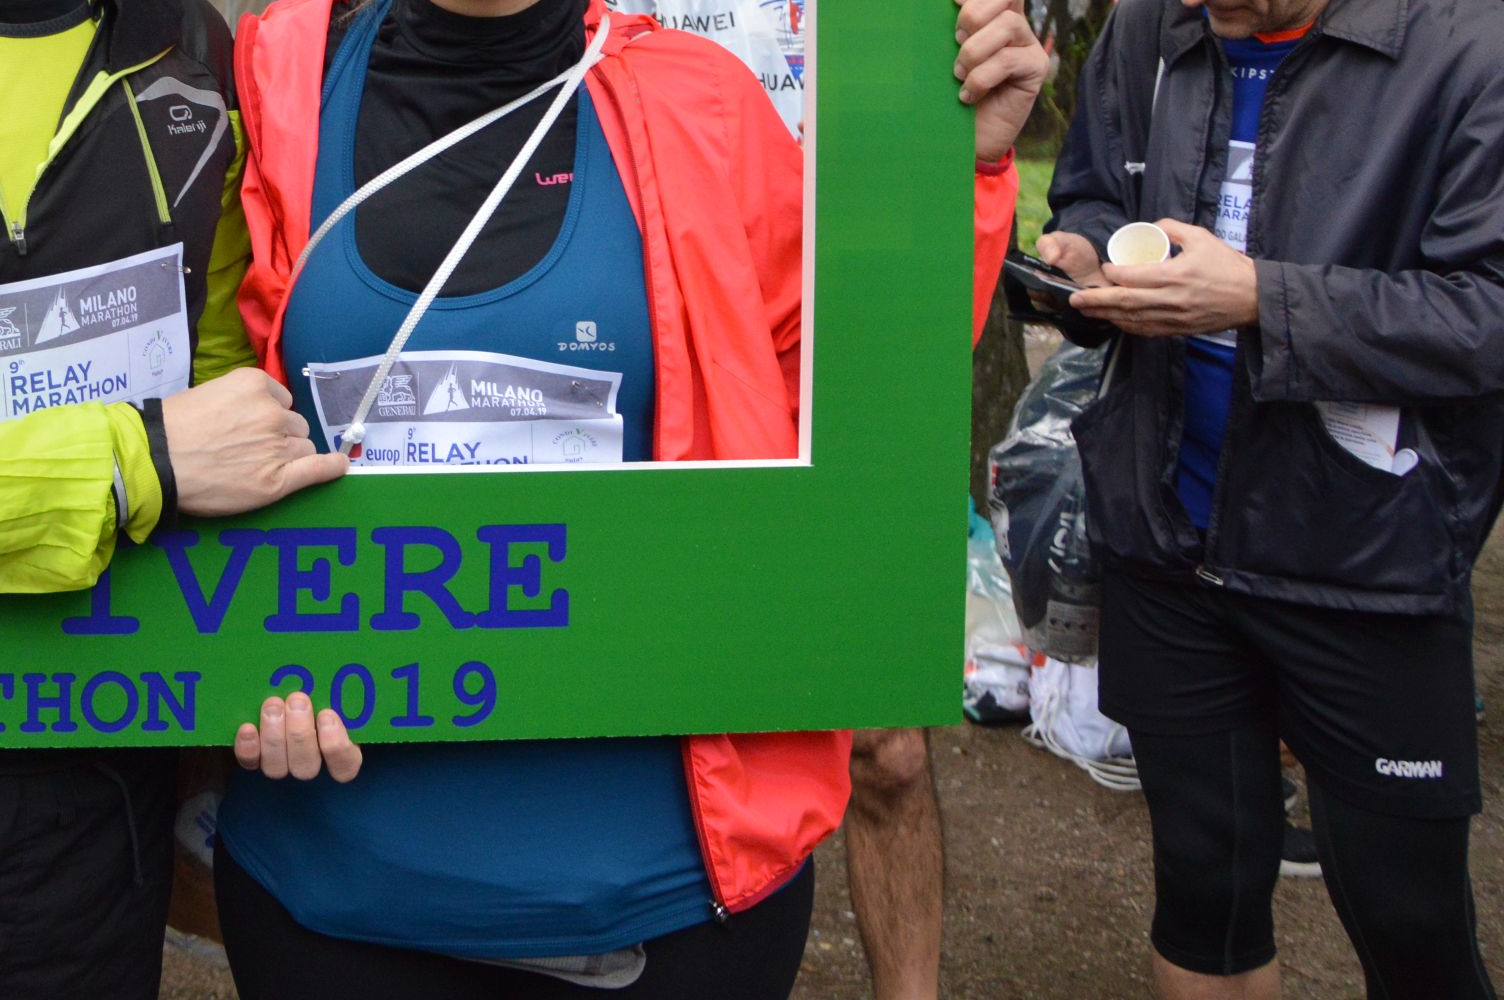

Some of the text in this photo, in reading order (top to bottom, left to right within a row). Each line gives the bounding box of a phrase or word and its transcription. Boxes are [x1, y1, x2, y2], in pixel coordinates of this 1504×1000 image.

[80, 286, 137, 314] MILANO
[81, 303, 137, 327] MARATHON
[111, 314, 138, 328] 07.04.19
[557, 342, 615, 351] DOMYOS
[11, 361, 92, 396] RELAY
[12, 373, 128, 416] MARATHON
[471, 379, 543, 402] MILANO
[511, 408, 547, 416] 07.04.19
[366, 447, 400, 465] europ
[407, 442, 482, 464] RELAY
